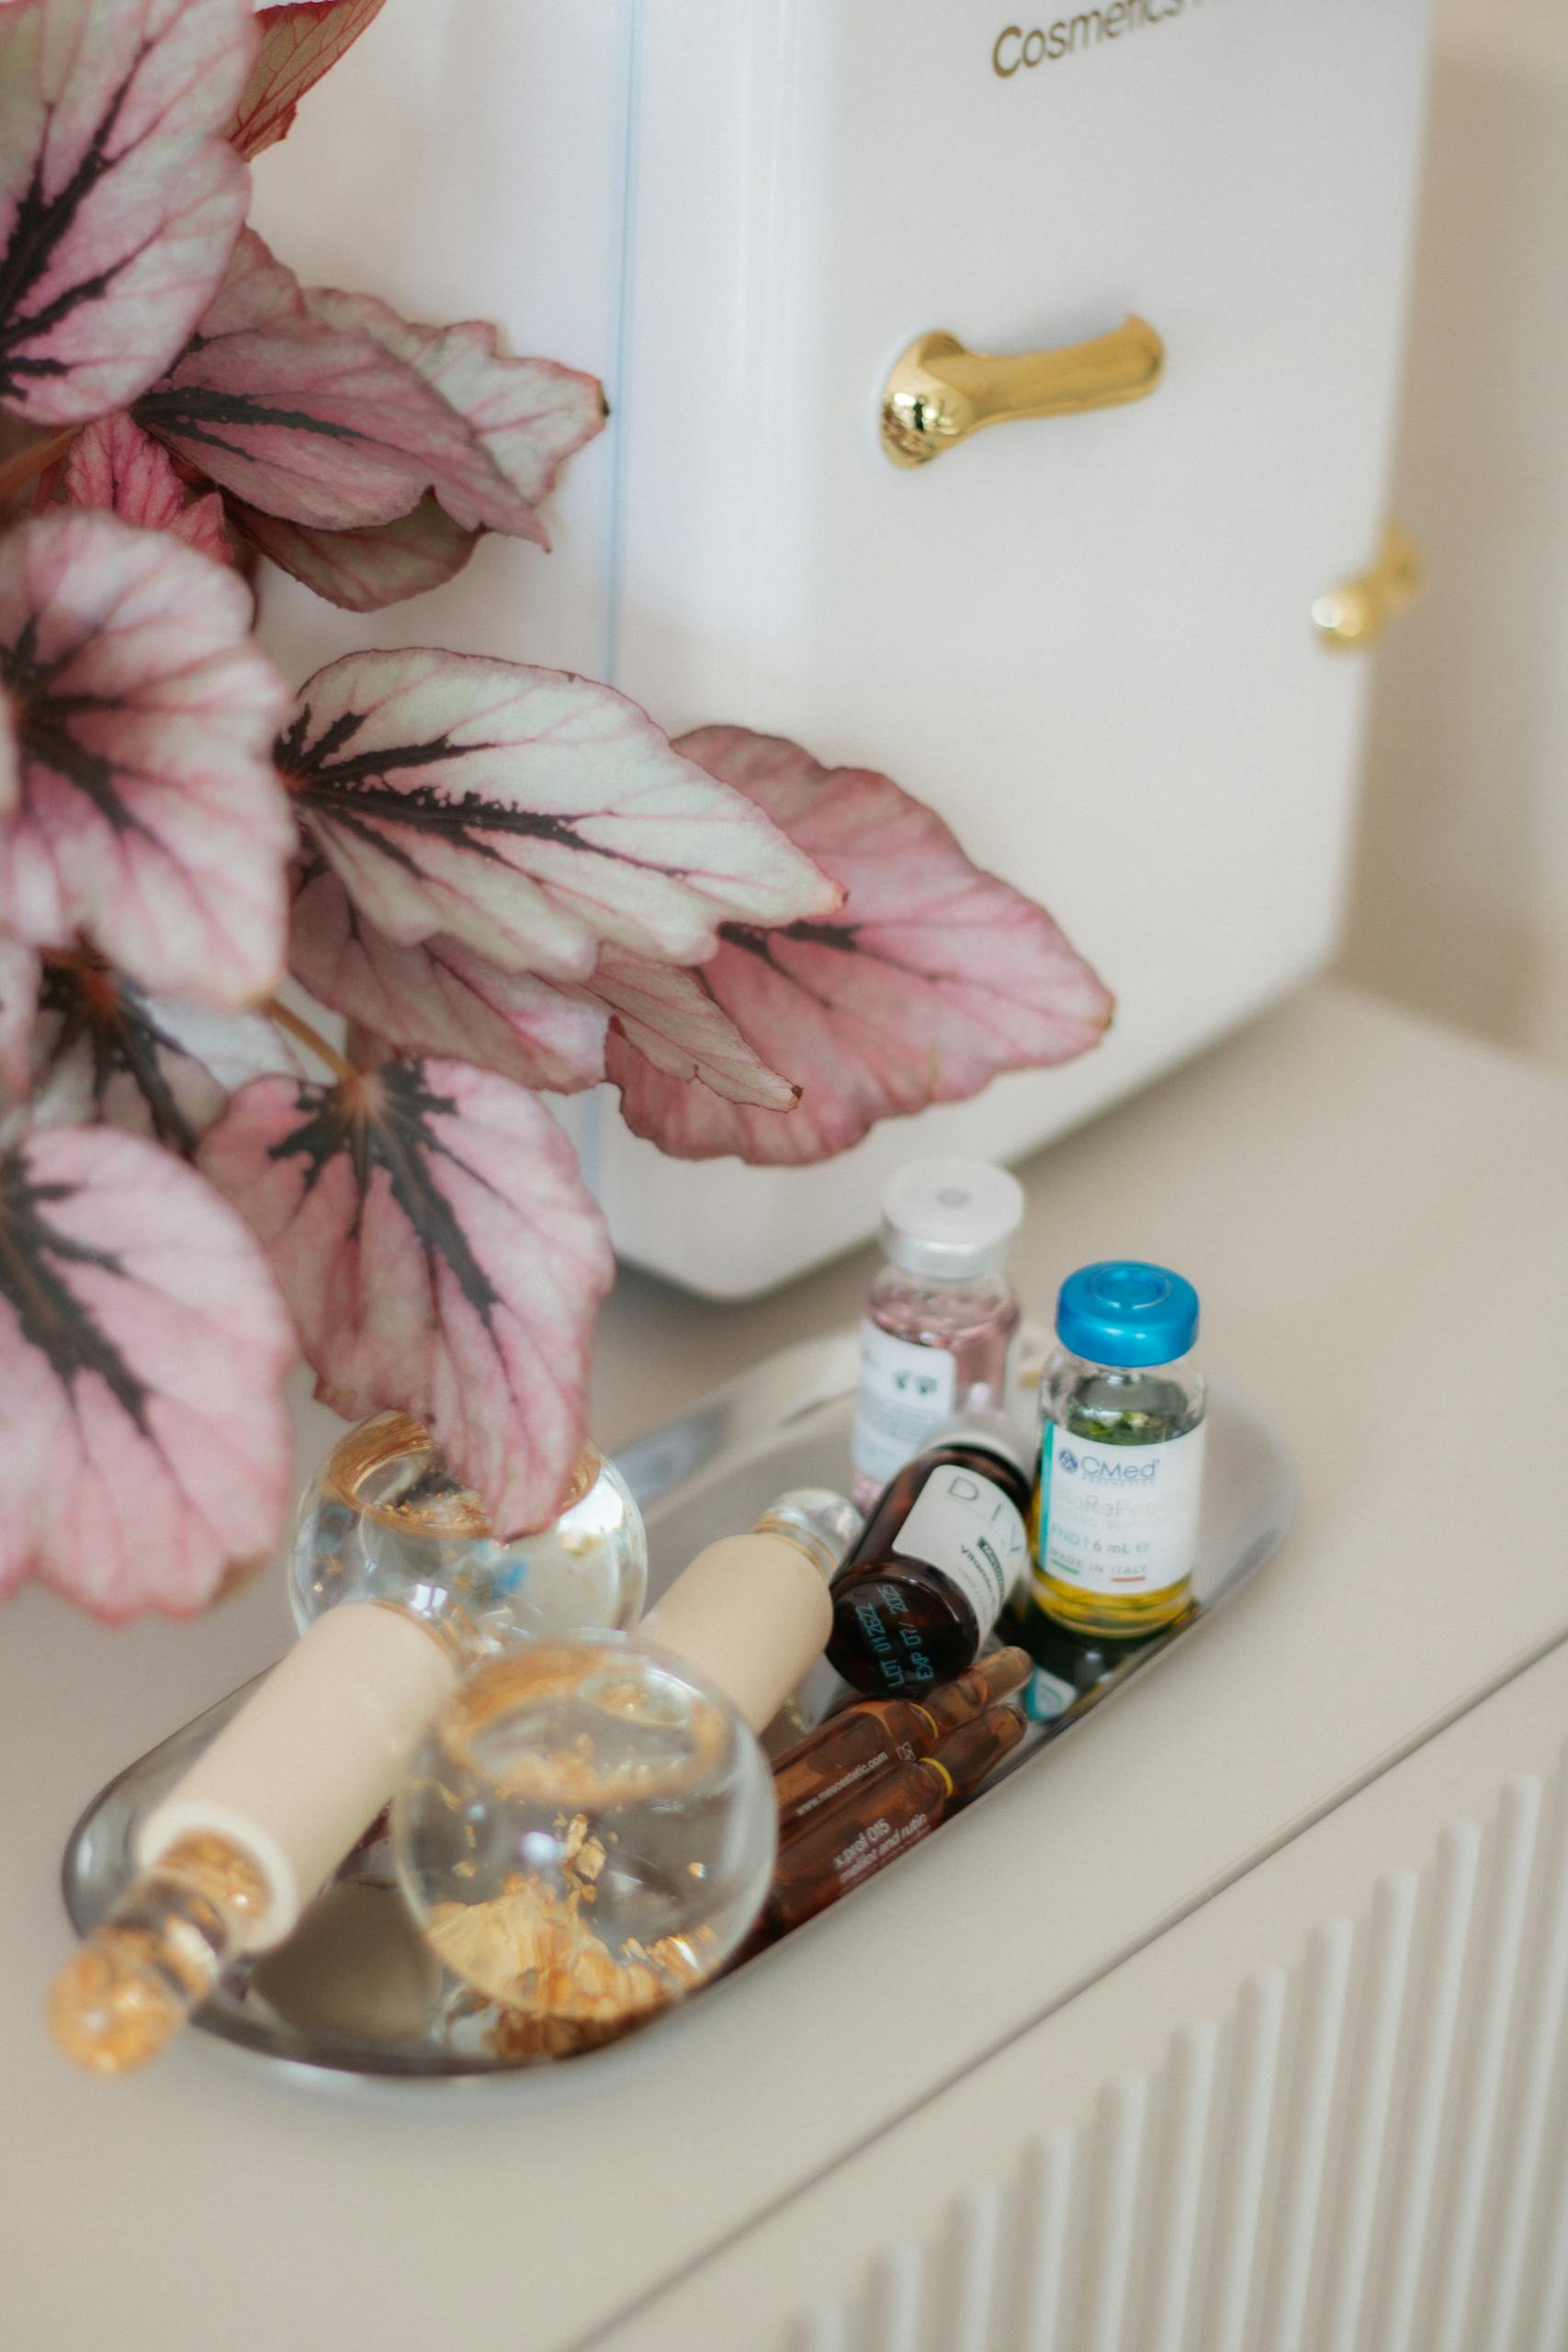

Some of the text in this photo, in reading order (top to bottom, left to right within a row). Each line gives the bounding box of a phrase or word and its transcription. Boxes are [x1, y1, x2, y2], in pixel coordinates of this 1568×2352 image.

[1092, 1538, 1103, 1553] 6
[1107, 1541, 1131, 1555] mL
[1111, 1564, 1146, 1575] ITALY
[879, 1658, 904, 1688] LOT
[910, 1653, 934, 1681] EXP
[866, 1817, 891, 1842] 015
[878, 1827, 900, 1853] and
[900, 1813, 929, 1838] rutin
